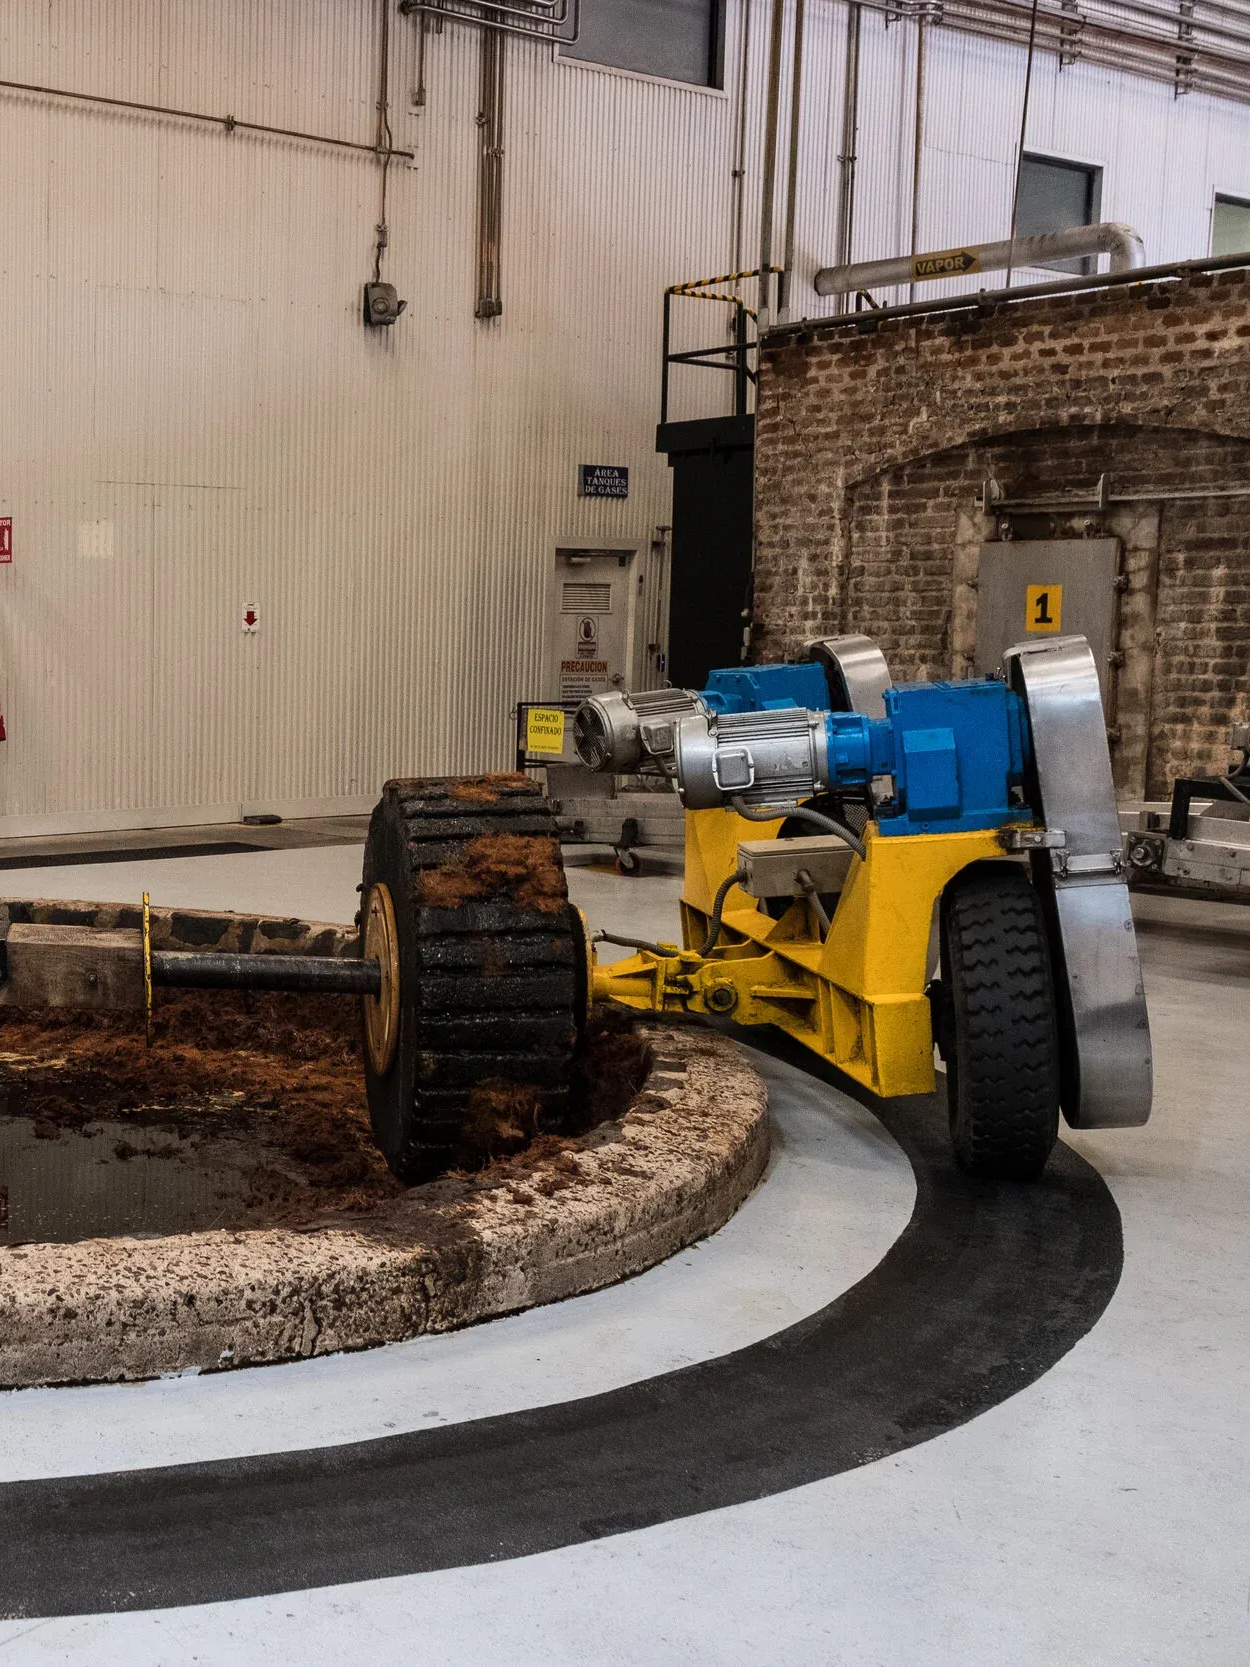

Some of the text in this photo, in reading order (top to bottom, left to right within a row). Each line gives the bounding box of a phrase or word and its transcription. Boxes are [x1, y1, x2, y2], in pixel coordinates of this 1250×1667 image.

[917, 256, 964, 274] VAPOR
[594, 467, 619, 477] ÁREA
[586, 477, 627, 486] TANQUES
[585, 485, 628, 495] DE GASES
[1034, 593, 1053, 624] 1
[534, 713, 559, 723] ESPACIO
[529, 725, 562, 735] CONFINADO
